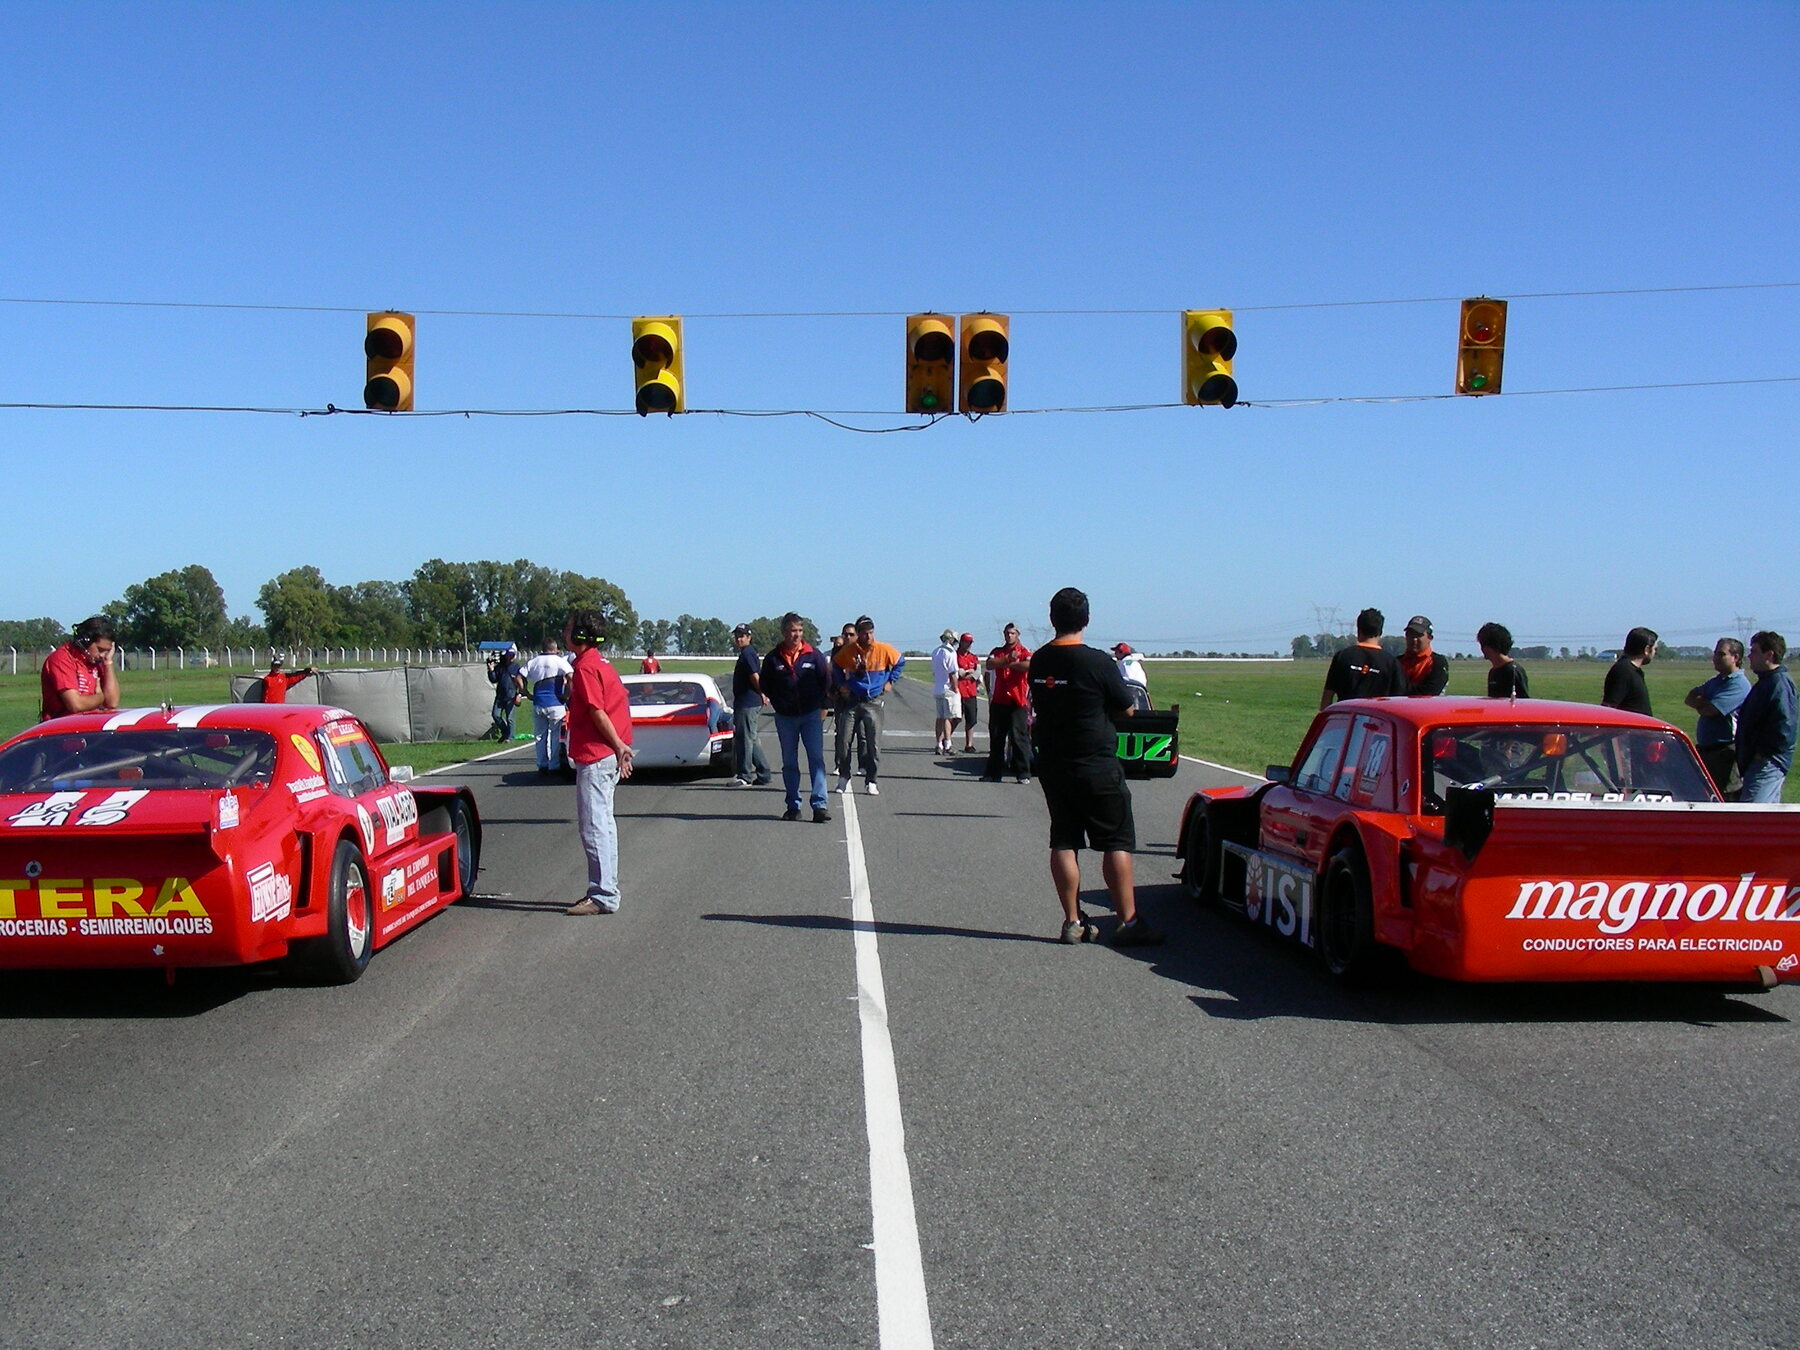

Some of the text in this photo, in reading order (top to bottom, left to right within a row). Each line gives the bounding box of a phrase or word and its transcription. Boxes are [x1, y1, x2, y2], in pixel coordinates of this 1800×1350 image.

[1364, 739, 1388, 778] 18
[1504, 871, 1800, 935] magnoluz
[79, 917, 214, 935] SEMIRREMOLQUES
[1523, 938, 1783, 952] CONDUCTORES PARA ELECTRICIDAD
